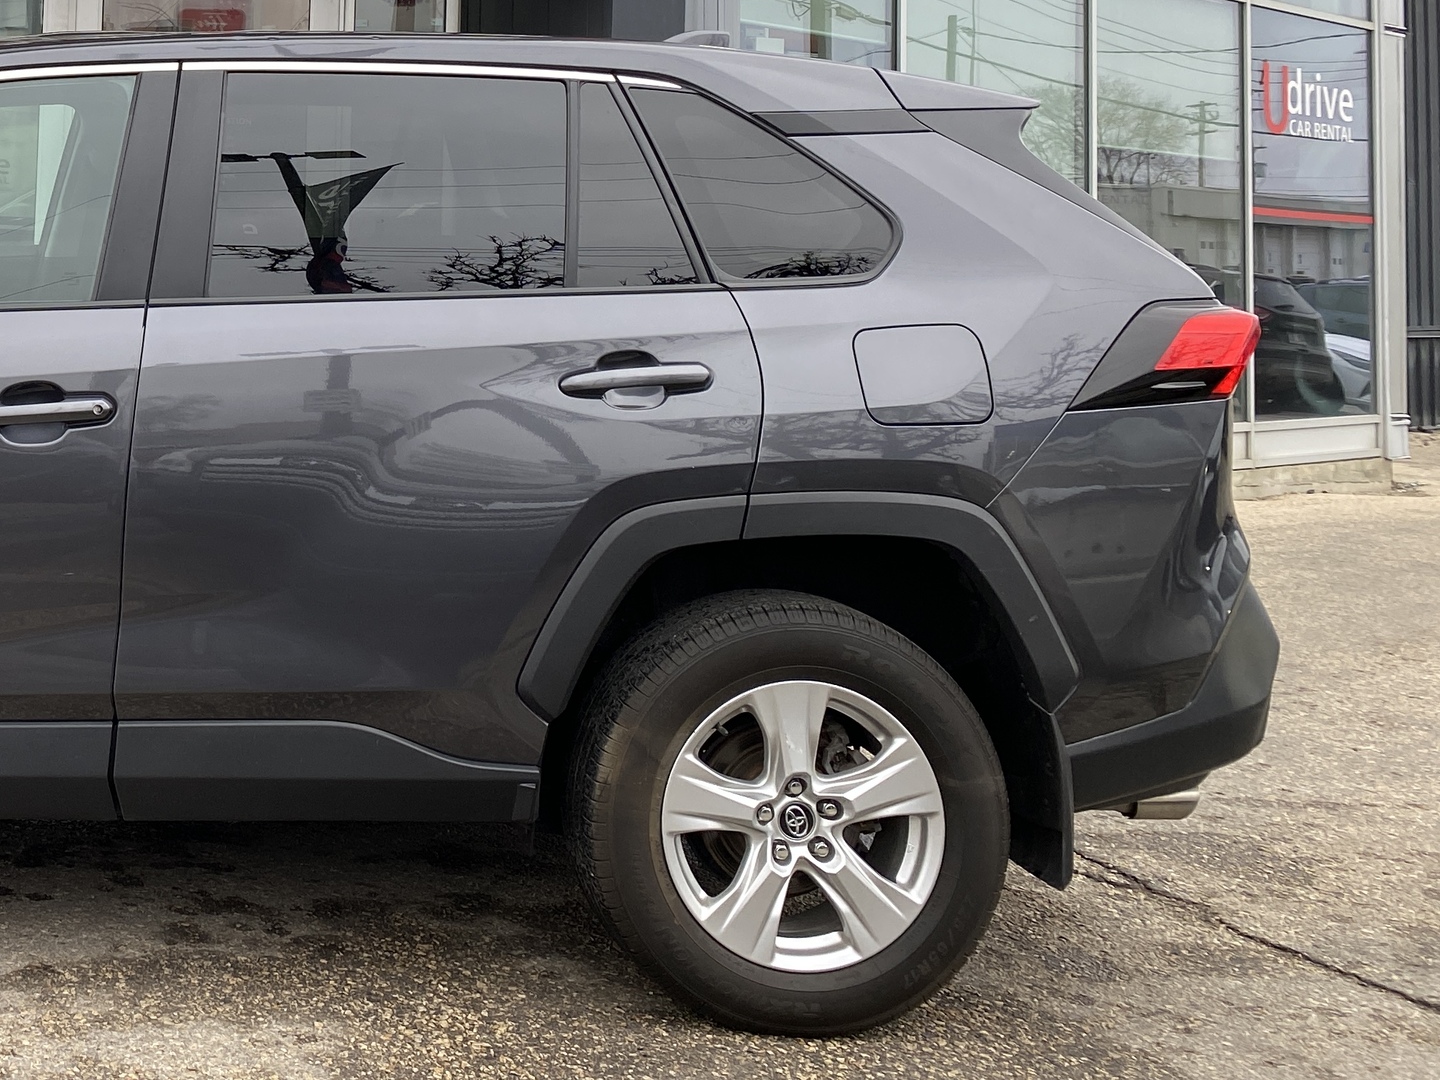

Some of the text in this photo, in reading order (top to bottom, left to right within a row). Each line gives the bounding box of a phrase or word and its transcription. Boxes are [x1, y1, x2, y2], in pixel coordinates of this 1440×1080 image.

[1262, 61, 1354, 135] Udrive
[1289, 120, 1355, 143] CAR RENTAL
